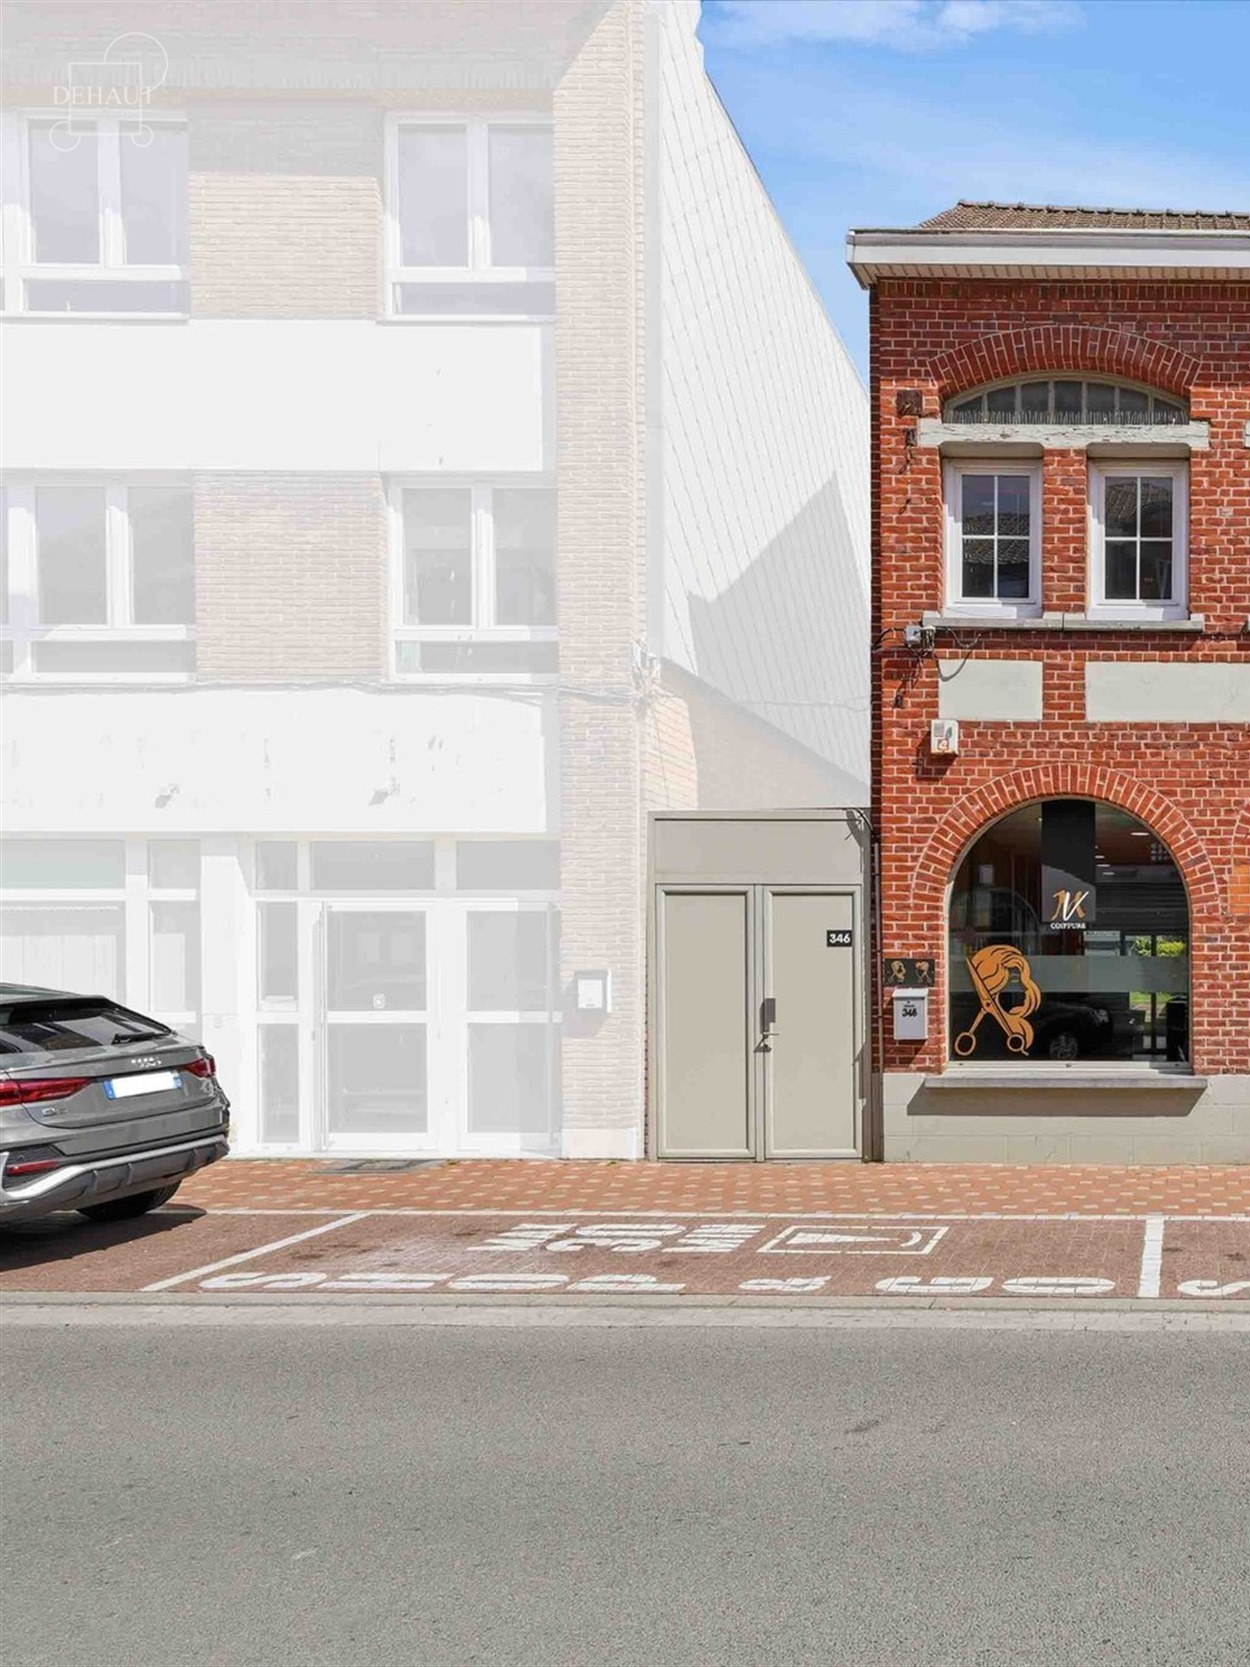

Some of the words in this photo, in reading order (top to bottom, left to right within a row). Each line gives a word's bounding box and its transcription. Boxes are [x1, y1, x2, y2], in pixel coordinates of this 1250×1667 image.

[1050, 922, 1087, 930] COIFFURE
[829, 932, 851, 944] 346
[661, 1224, 769, 1253] MIN
[198, 1271, 687, 1291] SHOP
[738, 1275, 834, 1292] &
[874, 1276, 1117, 1294] GO
